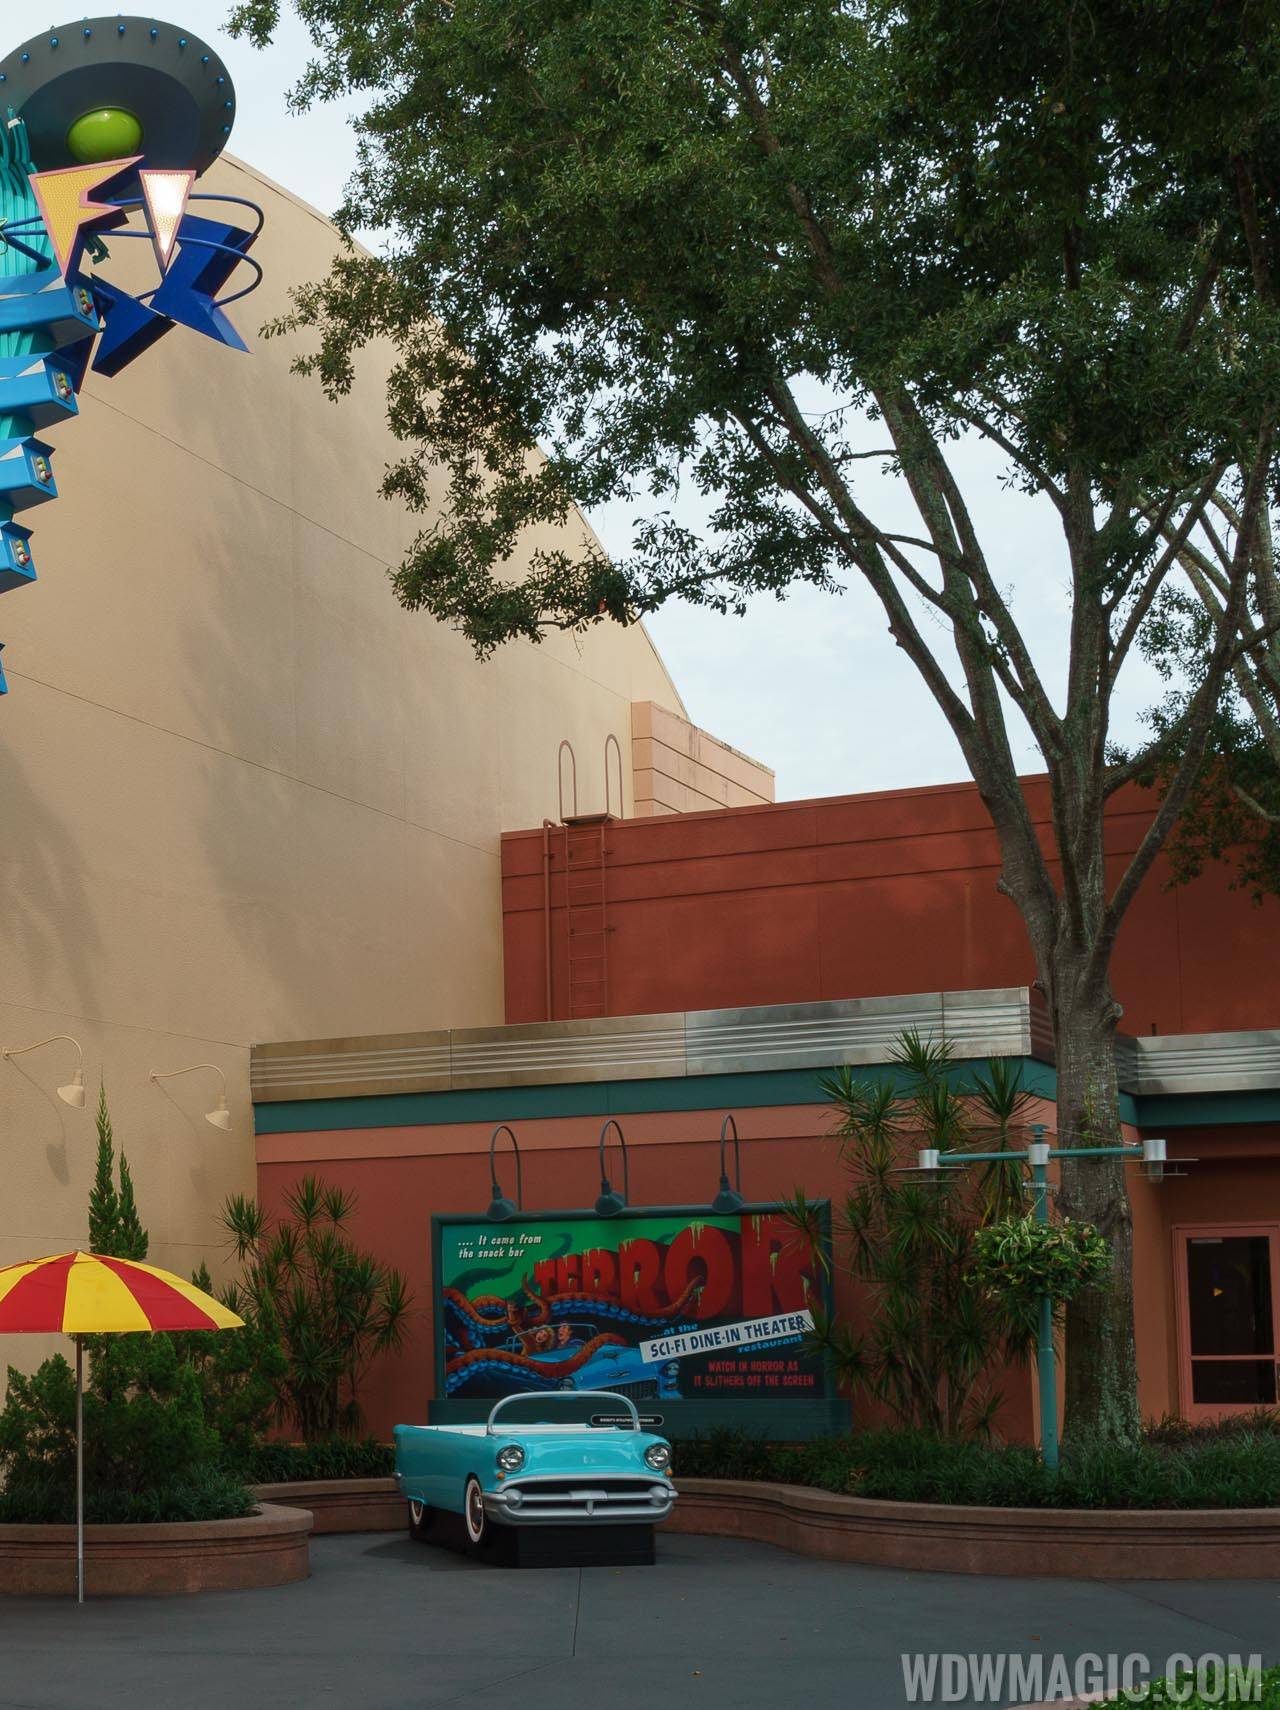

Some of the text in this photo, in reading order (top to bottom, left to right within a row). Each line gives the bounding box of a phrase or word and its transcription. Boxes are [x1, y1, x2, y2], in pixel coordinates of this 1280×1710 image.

[479, 1235, 488, 1245] It
[491, 1236, 515, 1245] came
[519, 1234, 542, 1245] from
[459, 1247, 524, 1258] the snack bar
[534, 1215, 813, 1319] TERROR
[677, 1323, 699, 1334] the
[651, 1315, 805, 1358] SCI-FI DINE-IN THEATER
[737, 1335, 803, 1353] restaurant
[708, 1360, 799, 1373] WATCH IN HORROR AS
[694, 1376, 815, 1388] IT SLITHERS OFF THE SCREEN
